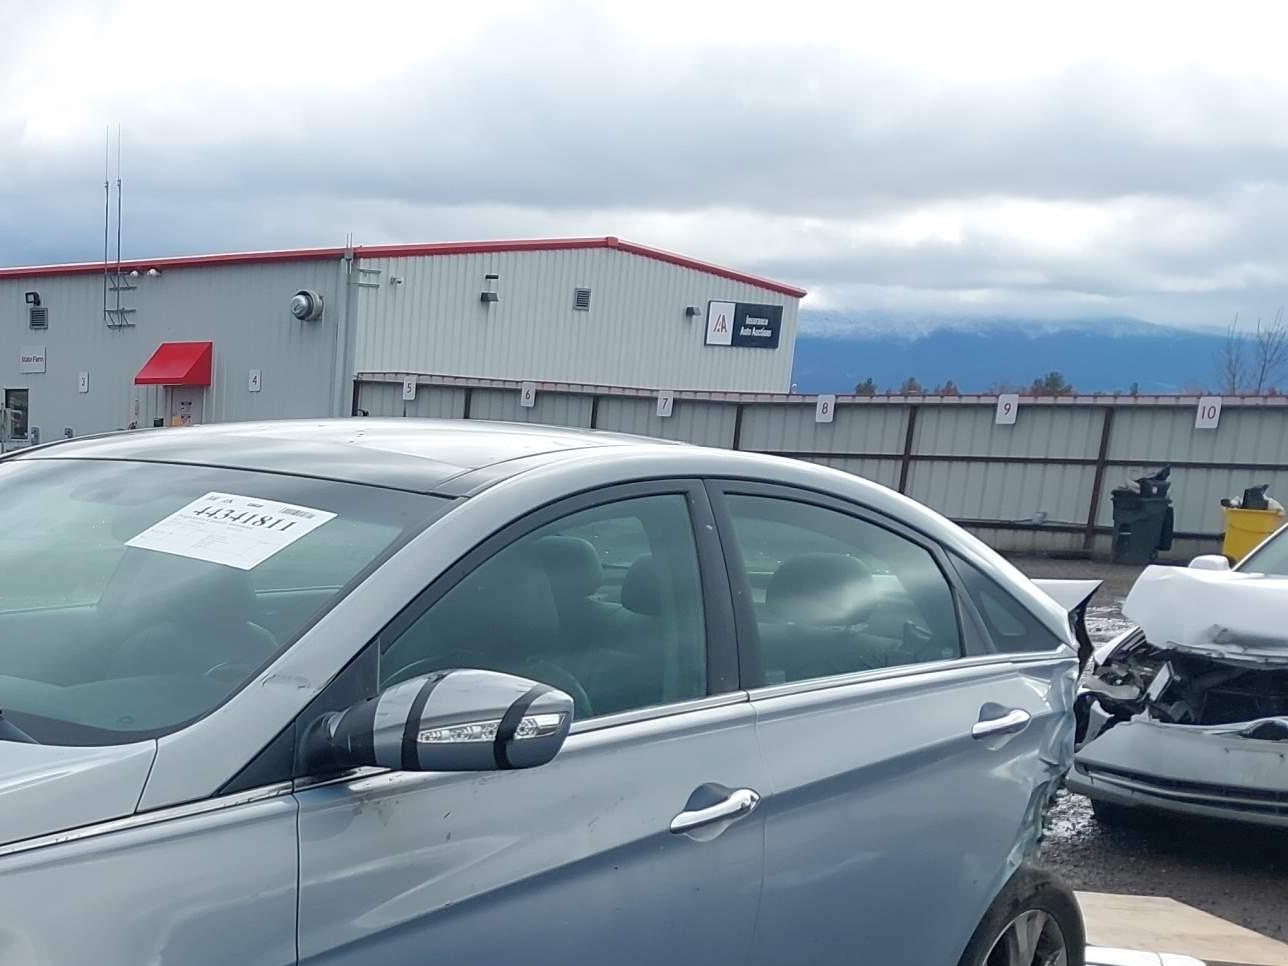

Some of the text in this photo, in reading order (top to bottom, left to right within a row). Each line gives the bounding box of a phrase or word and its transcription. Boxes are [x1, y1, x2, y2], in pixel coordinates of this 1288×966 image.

[740, 326, 772, 337] Auto Auctions
[252, 375, 257, 385] 4
[407, 383, 412, 393] 5
[525, 389, 531, 399] 6
[662, 397, 668, 410] 7
[822, 402, 828, 415] 8
[1003, 402, 1011, 415] 9
[1201, 406, 1217, 420] 10
[193, 505, 297, 532] 44341811
